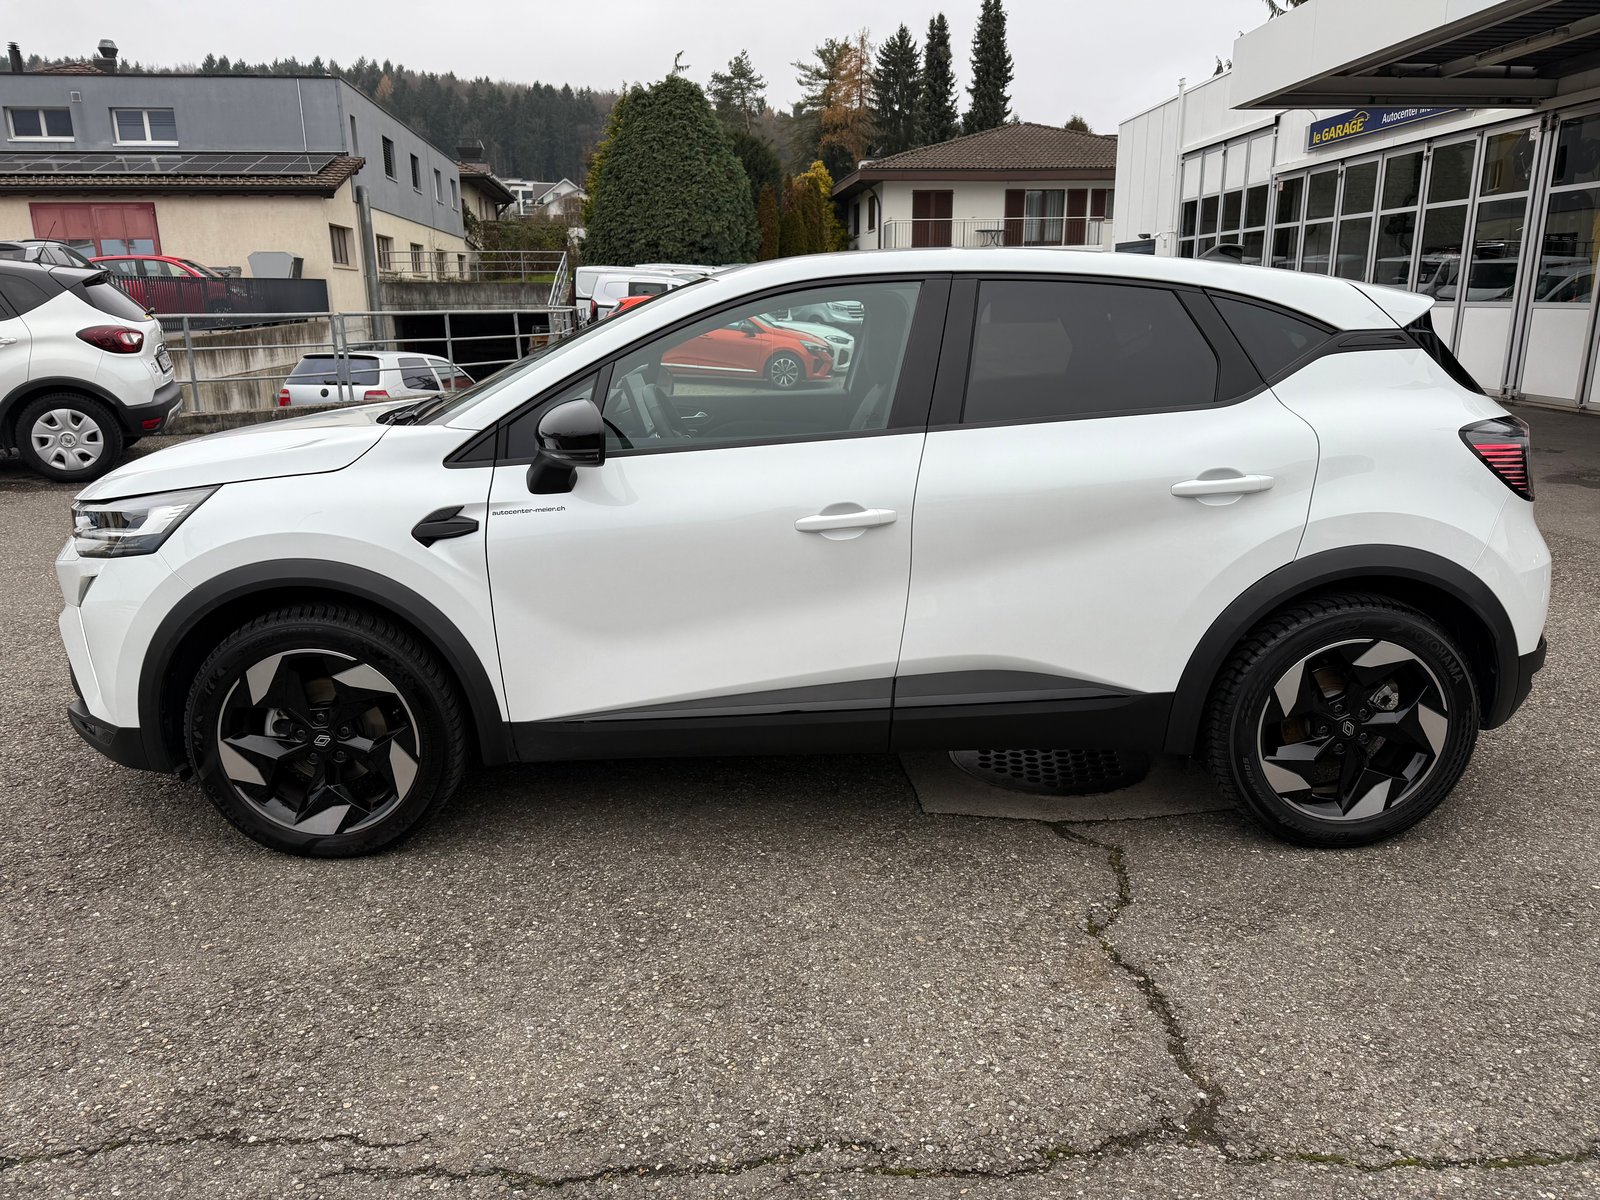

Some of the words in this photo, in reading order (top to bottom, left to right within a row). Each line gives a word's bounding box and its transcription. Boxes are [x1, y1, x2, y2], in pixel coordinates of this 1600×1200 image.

[1381, 108, 1418, 124] Autocenter
[1313, 131, 1321, 144] le
[1322, 118, 1365, 141] GARAGE
[491, 505, 566, 516] autocenter-meier.ch
[1409, 627, 1464, 685] YOKOHAMA
